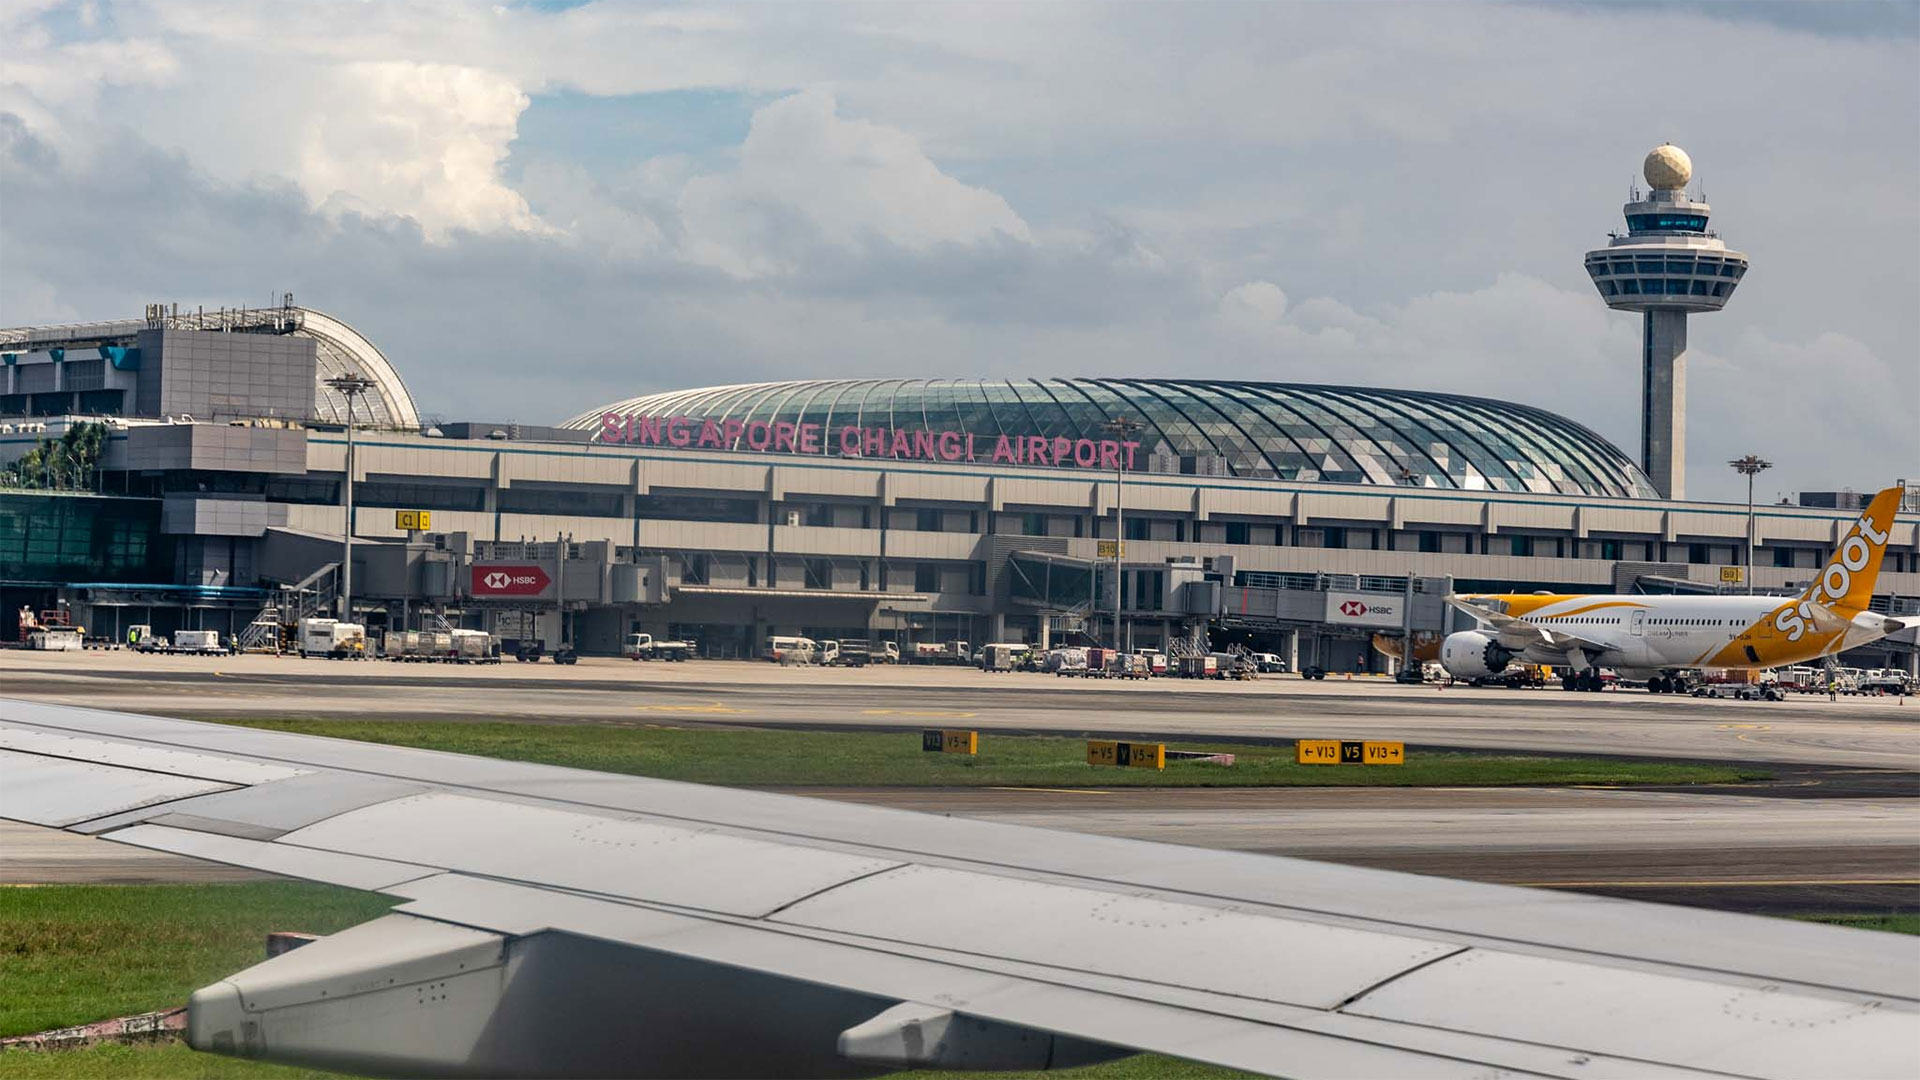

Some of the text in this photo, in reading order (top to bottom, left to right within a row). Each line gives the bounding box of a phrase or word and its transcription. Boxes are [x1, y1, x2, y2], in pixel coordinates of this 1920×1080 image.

[600, 413, 1140, 470] SINGAPORE CHANGI AIRPORT
[402, 514, 412, 526] C1
[513, 576, 536, 585] HSBC
[1775, 516, 1889, 642] scoot
[1368, 606, 1393, 615] HSBC
[947, 736, 959, 748] V5
[1100, 746, 1145, 761] V5 V V5
[1316, 746, 1388, 758] V13 V5 V13
